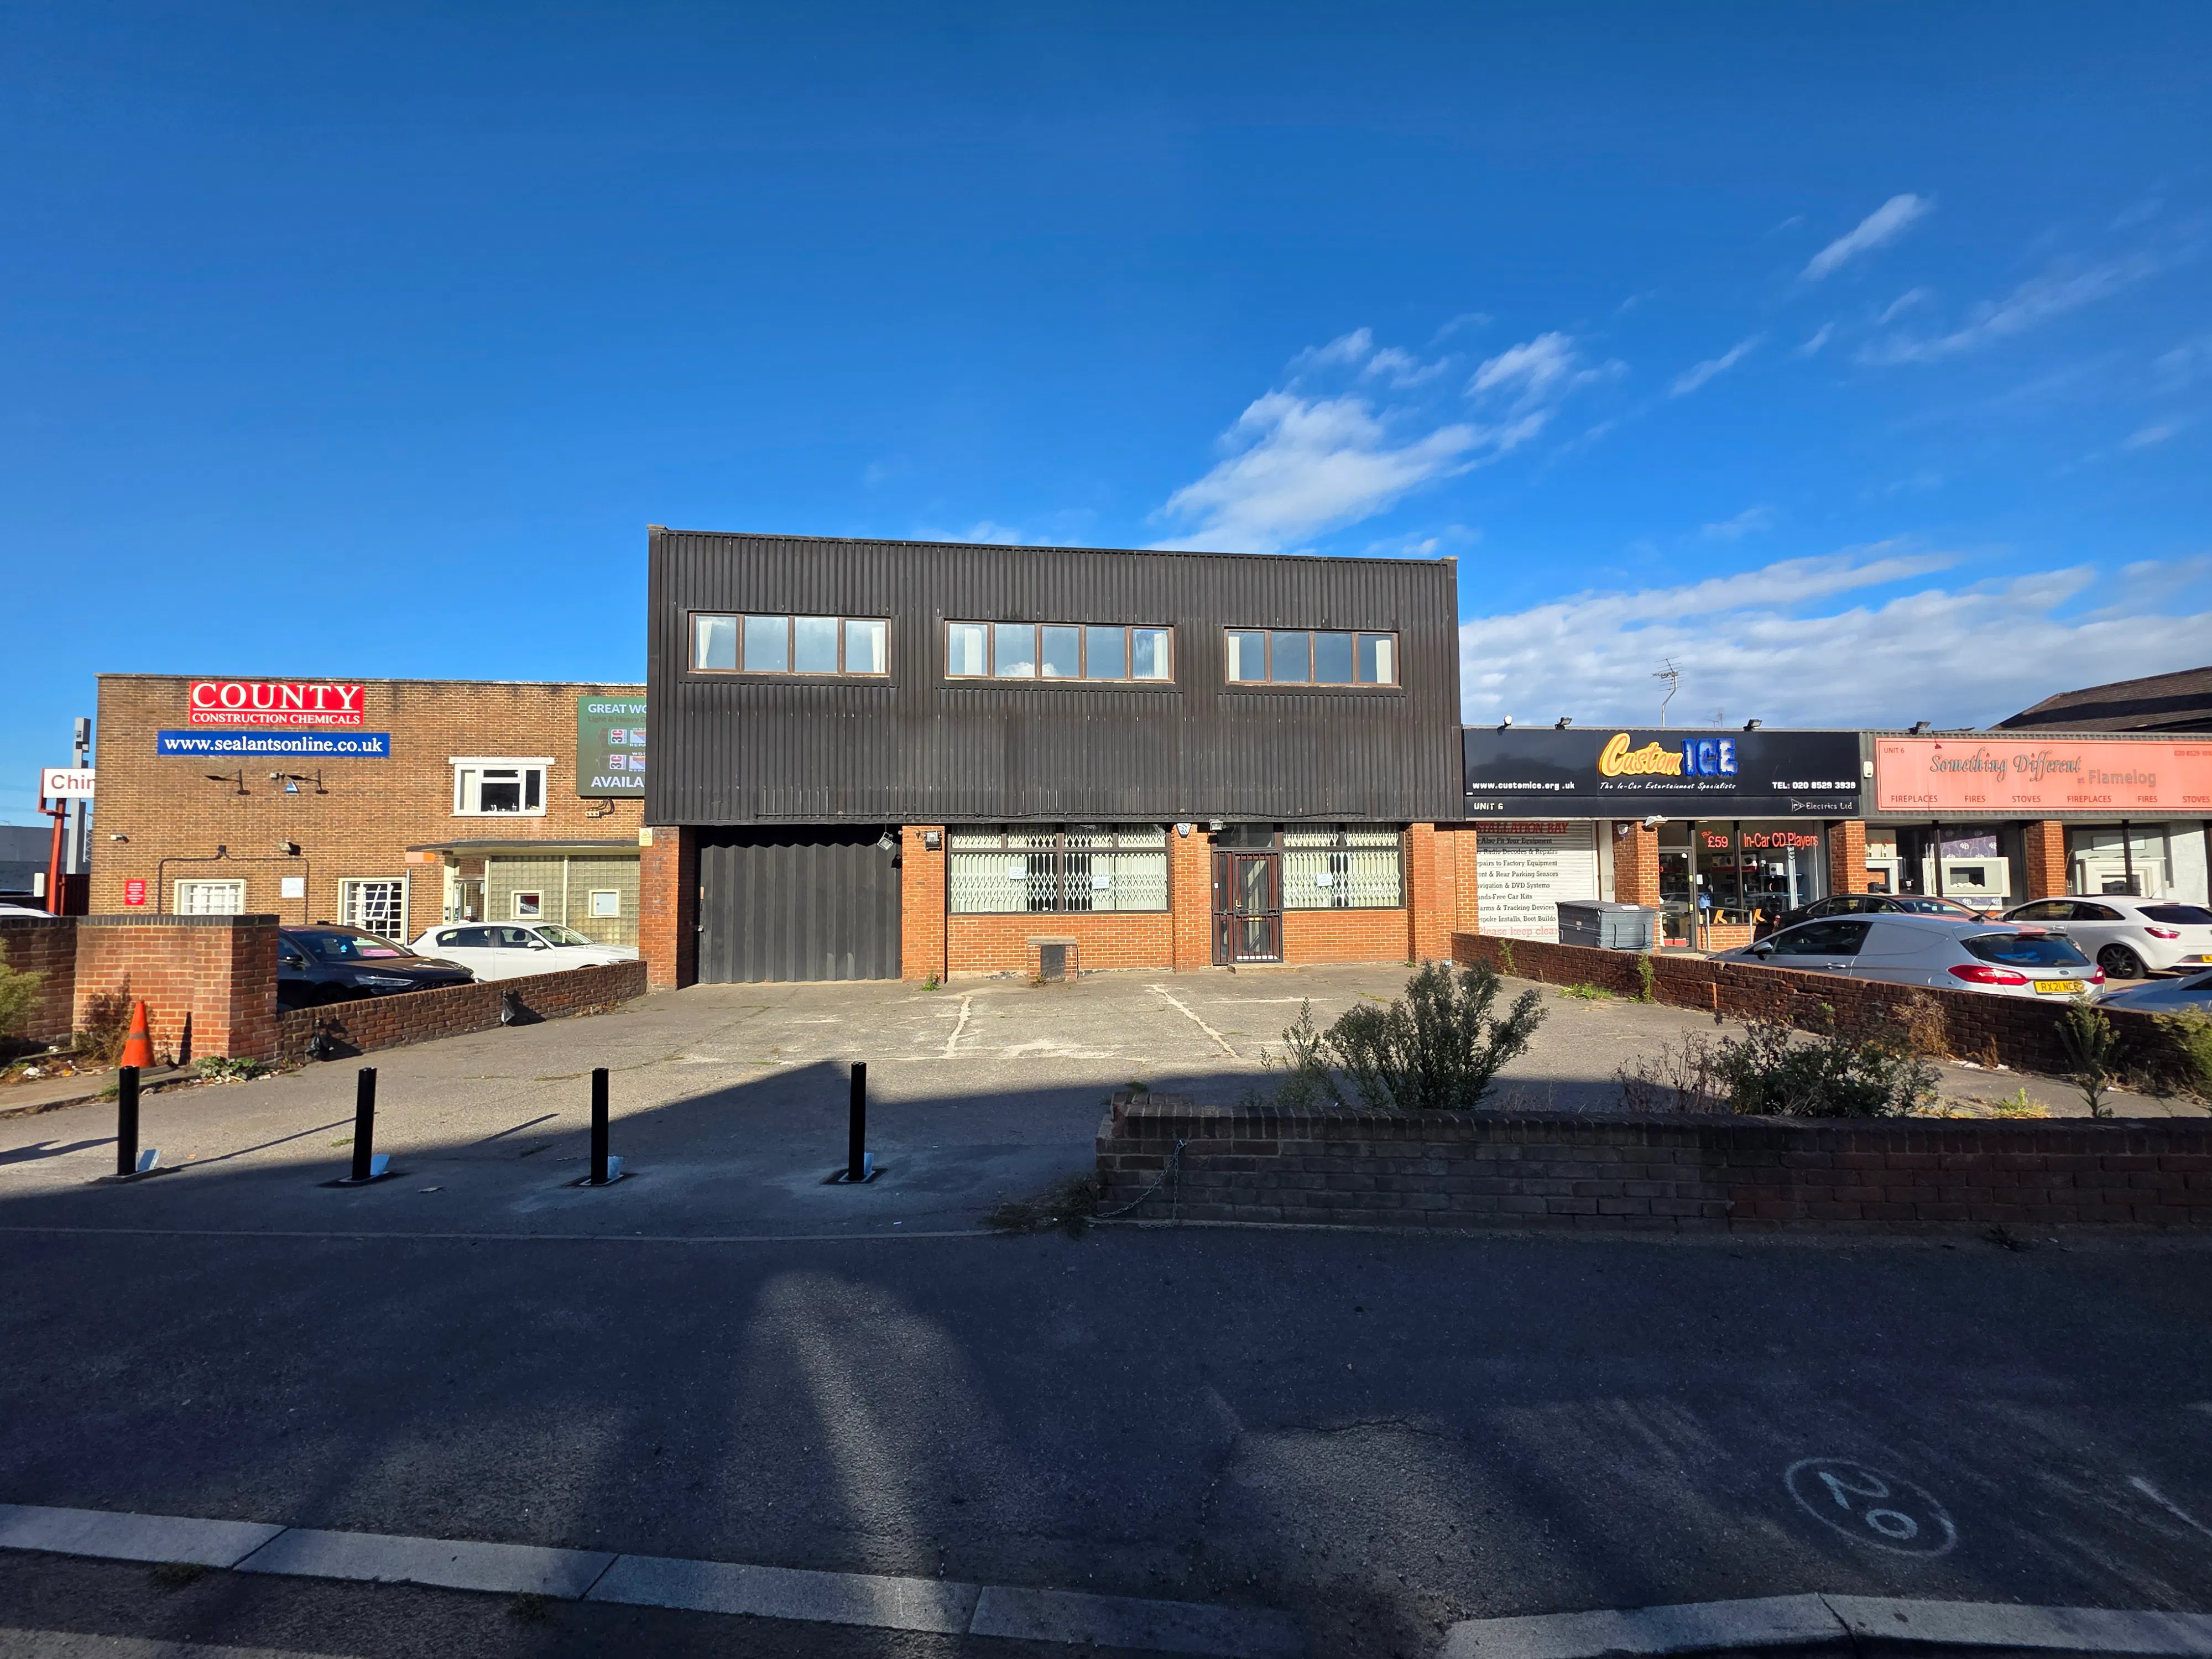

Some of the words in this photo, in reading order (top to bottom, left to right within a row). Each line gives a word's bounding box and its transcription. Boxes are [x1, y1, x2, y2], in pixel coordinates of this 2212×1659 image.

[192, 683, 360, 709] COUNTY
[588, 704, 627, 713] GREAT
[192, 713, 287, 723] CONSTRUCTION
[290, 714, 360, 724] CHEMICALS
[164, 736, 383, 752] www.sealantsonline.co.uk
[1599, 733, 1683, 777] Custom
[1682, 738, 1738, 776] ICE
[1930, 747, 2007, 782] Something
[2013, 750, 2081, 782] Different
[591, 776, 644, 787] AVAILA
[2088, 769, 2156, 787] Flamelog
[1697, 781, 1736, 791] Specialists
[1546, 822, 1568, 833] BAY
[1708, 836, 1729, 848] £59
[1744, 832, 1770, 847] In-Car
[1772, 832, 1786, 847] CD
[1787, 832, 1818, 849] Players
[1510, 926, 1532, 937] keep
[2041, 982, 2062, 992] RX21
